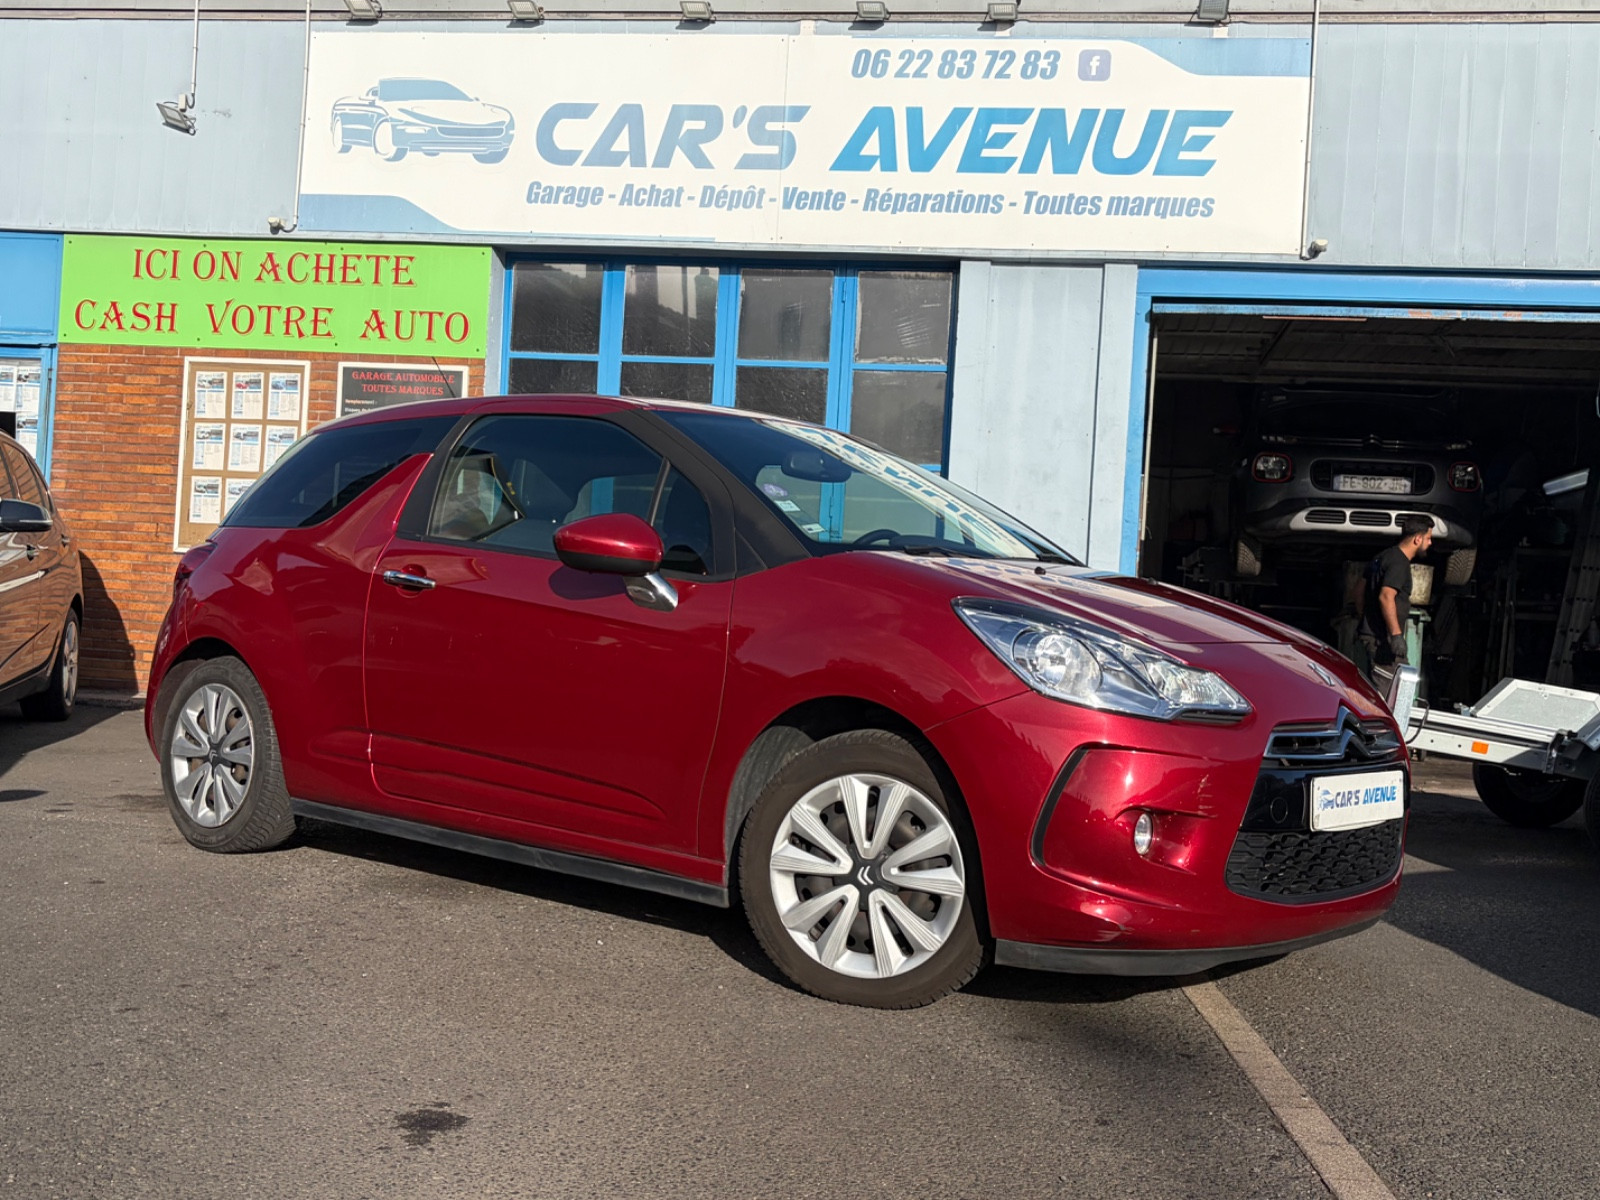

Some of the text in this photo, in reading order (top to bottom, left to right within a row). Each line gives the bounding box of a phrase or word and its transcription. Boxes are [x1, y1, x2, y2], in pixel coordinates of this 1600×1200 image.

[851, 48, 1061, 80] 06 22 83 72 83
[536, 102, 1234, 177] CAR'S AVENUE
[526, 181, 604, 208] Garage
[618, 183, 684, 208] Achat
[699, 184, 766, 211] Dépôt
[782, 186, 847, 211] Vente
[862, 187, 1005, 214] Réparations
[1023, 190, 1103, 216] Toutes
[1105, 195, 1215, 219] marques
[133, 248, 416, 287] ICI ON ACHETE
[74, 298, 470, 344] CASH VOTRE AUTO
[352, 371, 393, 381] GARAGE
[362, 384, 444, 395] TOUTES MARQUES
[1335, 785, 1397, 808] CAR'S AVENUE
